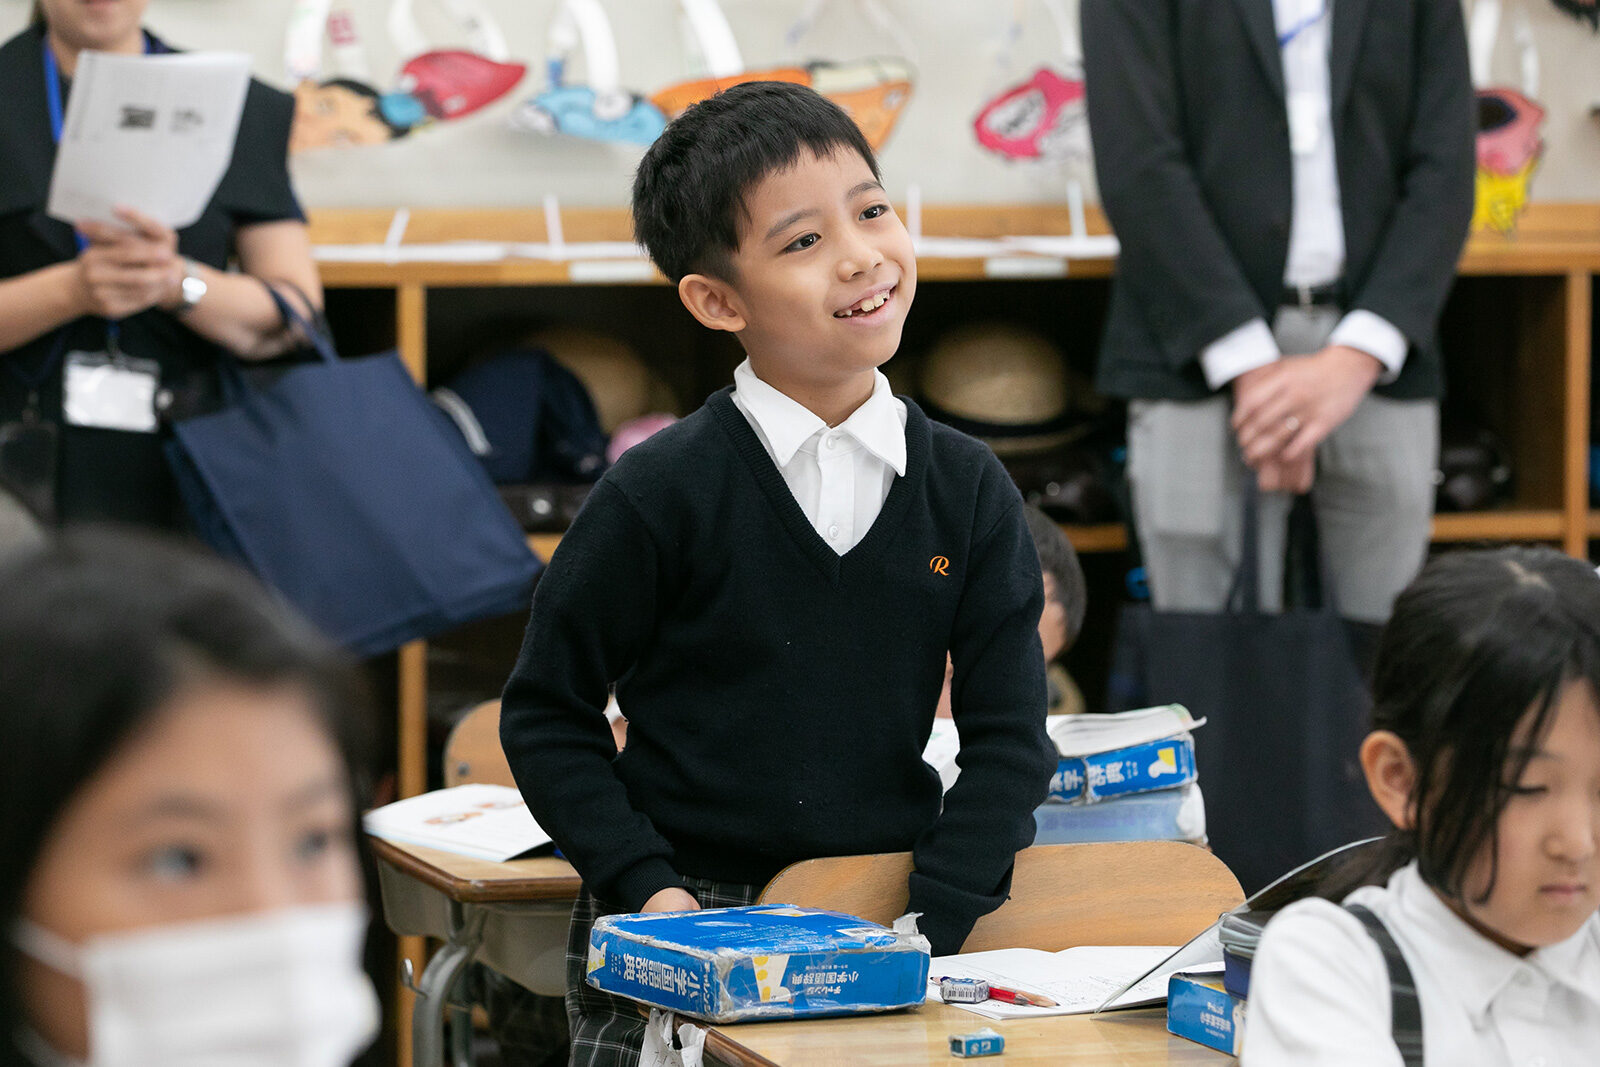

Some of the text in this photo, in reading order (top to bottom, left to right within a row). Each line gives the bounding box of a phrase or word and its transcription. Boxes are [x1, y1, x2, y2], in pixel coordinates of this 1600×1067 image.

[929, 555, 950, 577] R
[623, 953, 700, 998] 小学国語辞典
[792, 971, 859, 985] 小学国語辞典
[806, 985, 841, 995] チャレンジ
